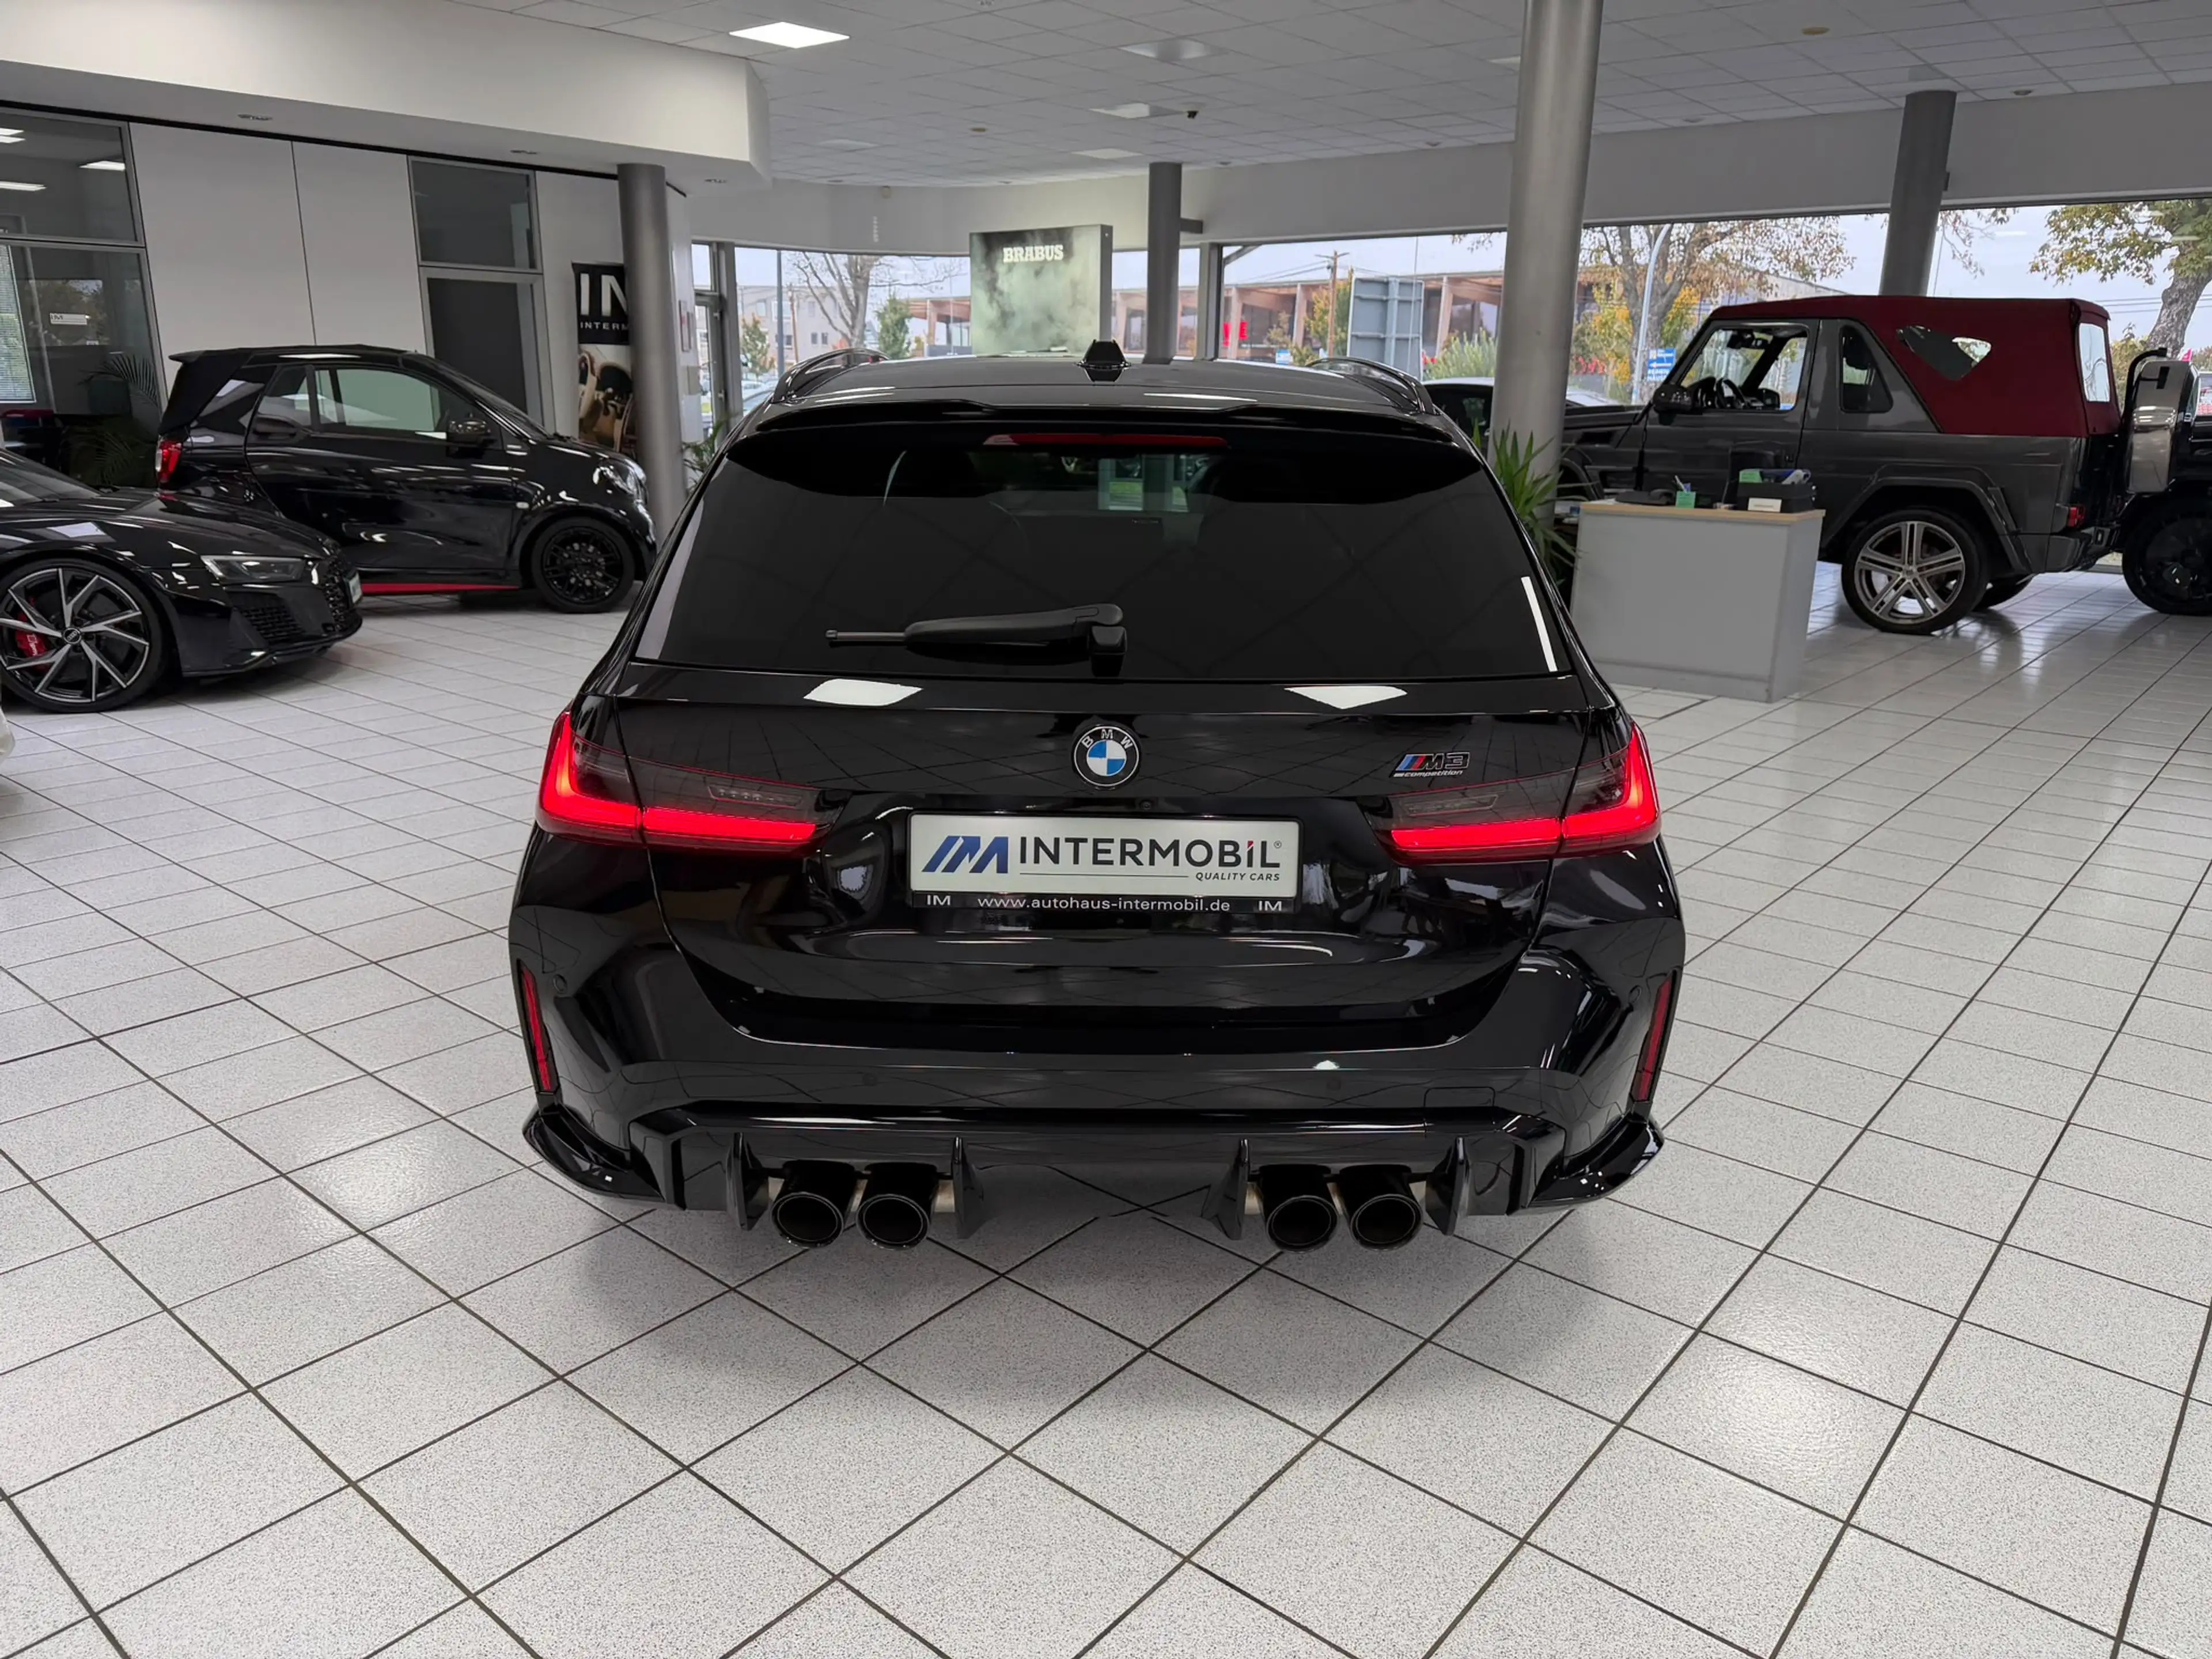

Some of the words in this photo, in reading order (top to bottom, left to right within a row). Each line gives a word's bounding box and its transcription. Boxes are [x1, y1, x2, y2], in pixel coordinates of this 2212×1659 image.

[1003, 244, 1063, 263] BRABUS
[1081, 729, 1134, 749] BMW
[1407, 752, 1470, 770] M3
[1195, 872, 1246, 881] QUALITY
[1249, 873, 1280, 881] CARS
[926, 895, 951, 906] IM
[978, 896, 1230, 911] www.autohaus-intermobil.de
[1258, 900, 1282, 911] IM
